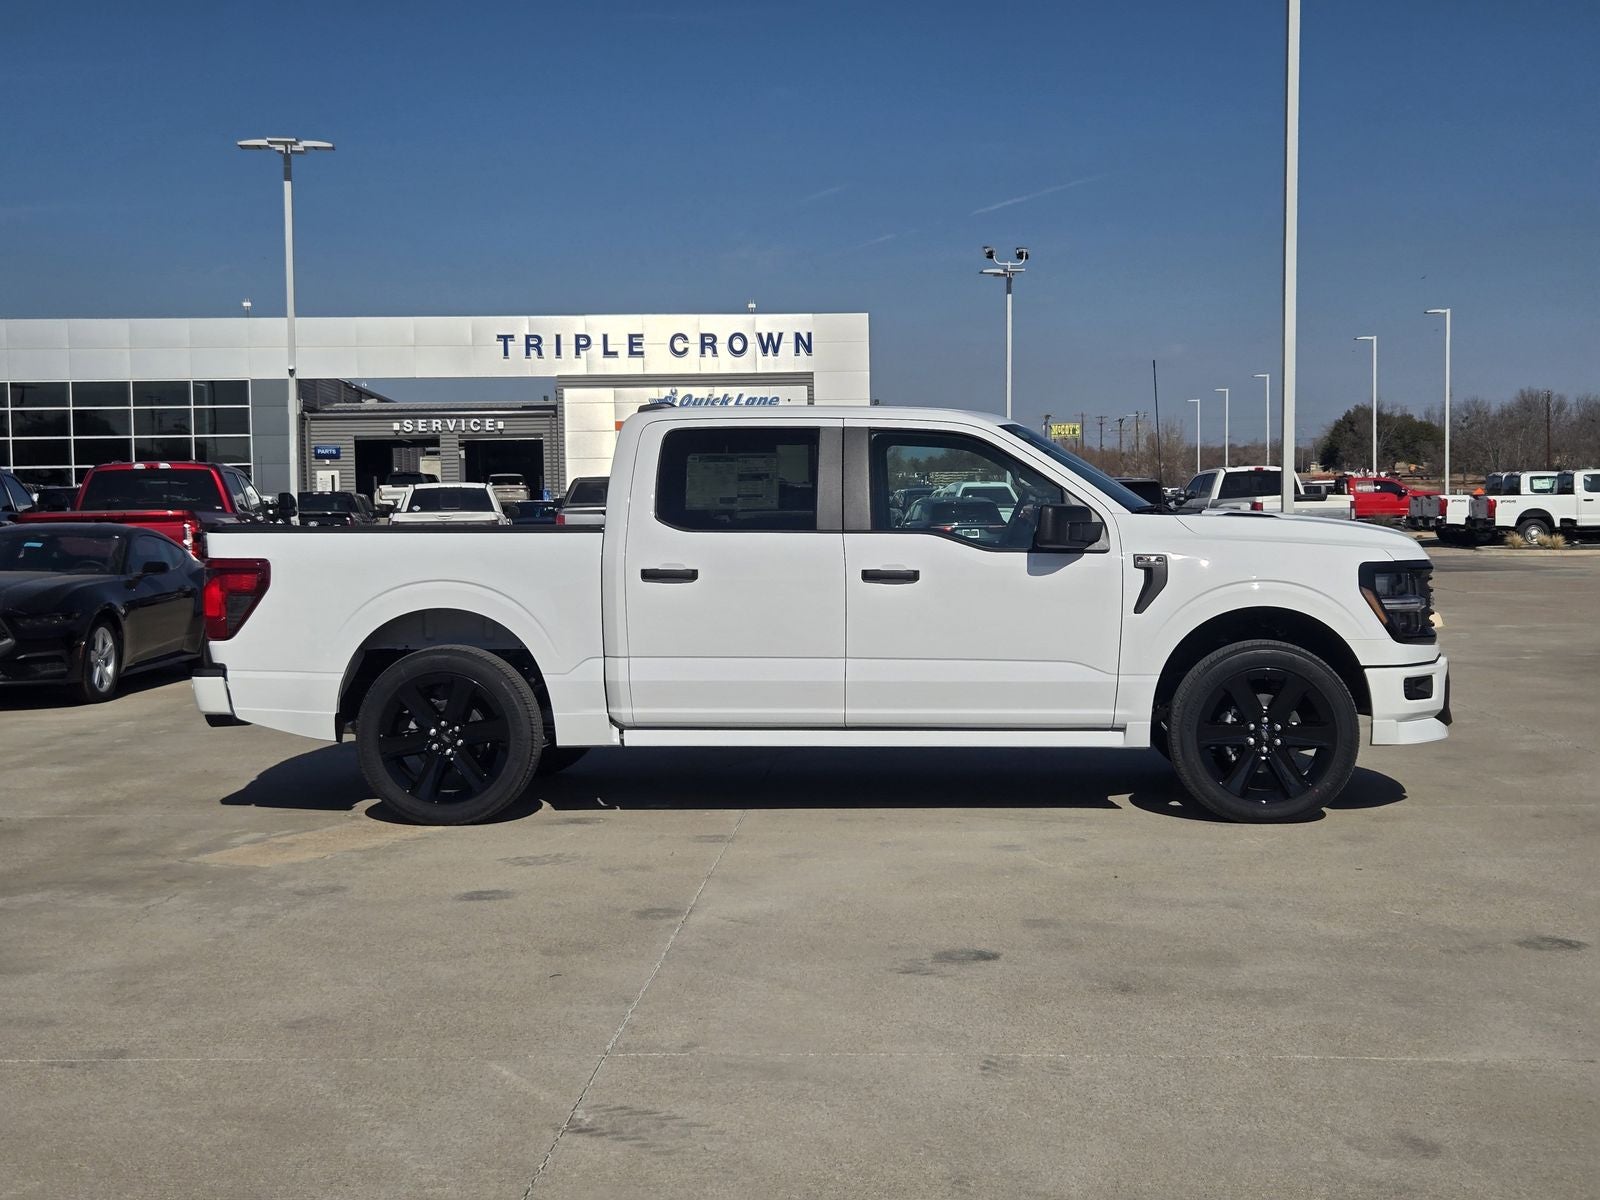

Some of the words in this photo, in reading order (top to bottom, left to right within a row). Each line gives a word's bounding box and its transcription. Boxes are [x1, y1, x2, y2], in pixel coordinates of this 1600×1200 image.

[496, 333, 645, 359] TRIPLE
[669, 331, 813, 358] CROWN
[679, 393, 734, 407] Quick
[734, 392, 780, 406] Lane
[403, 418, 495, 432] SERVICE
